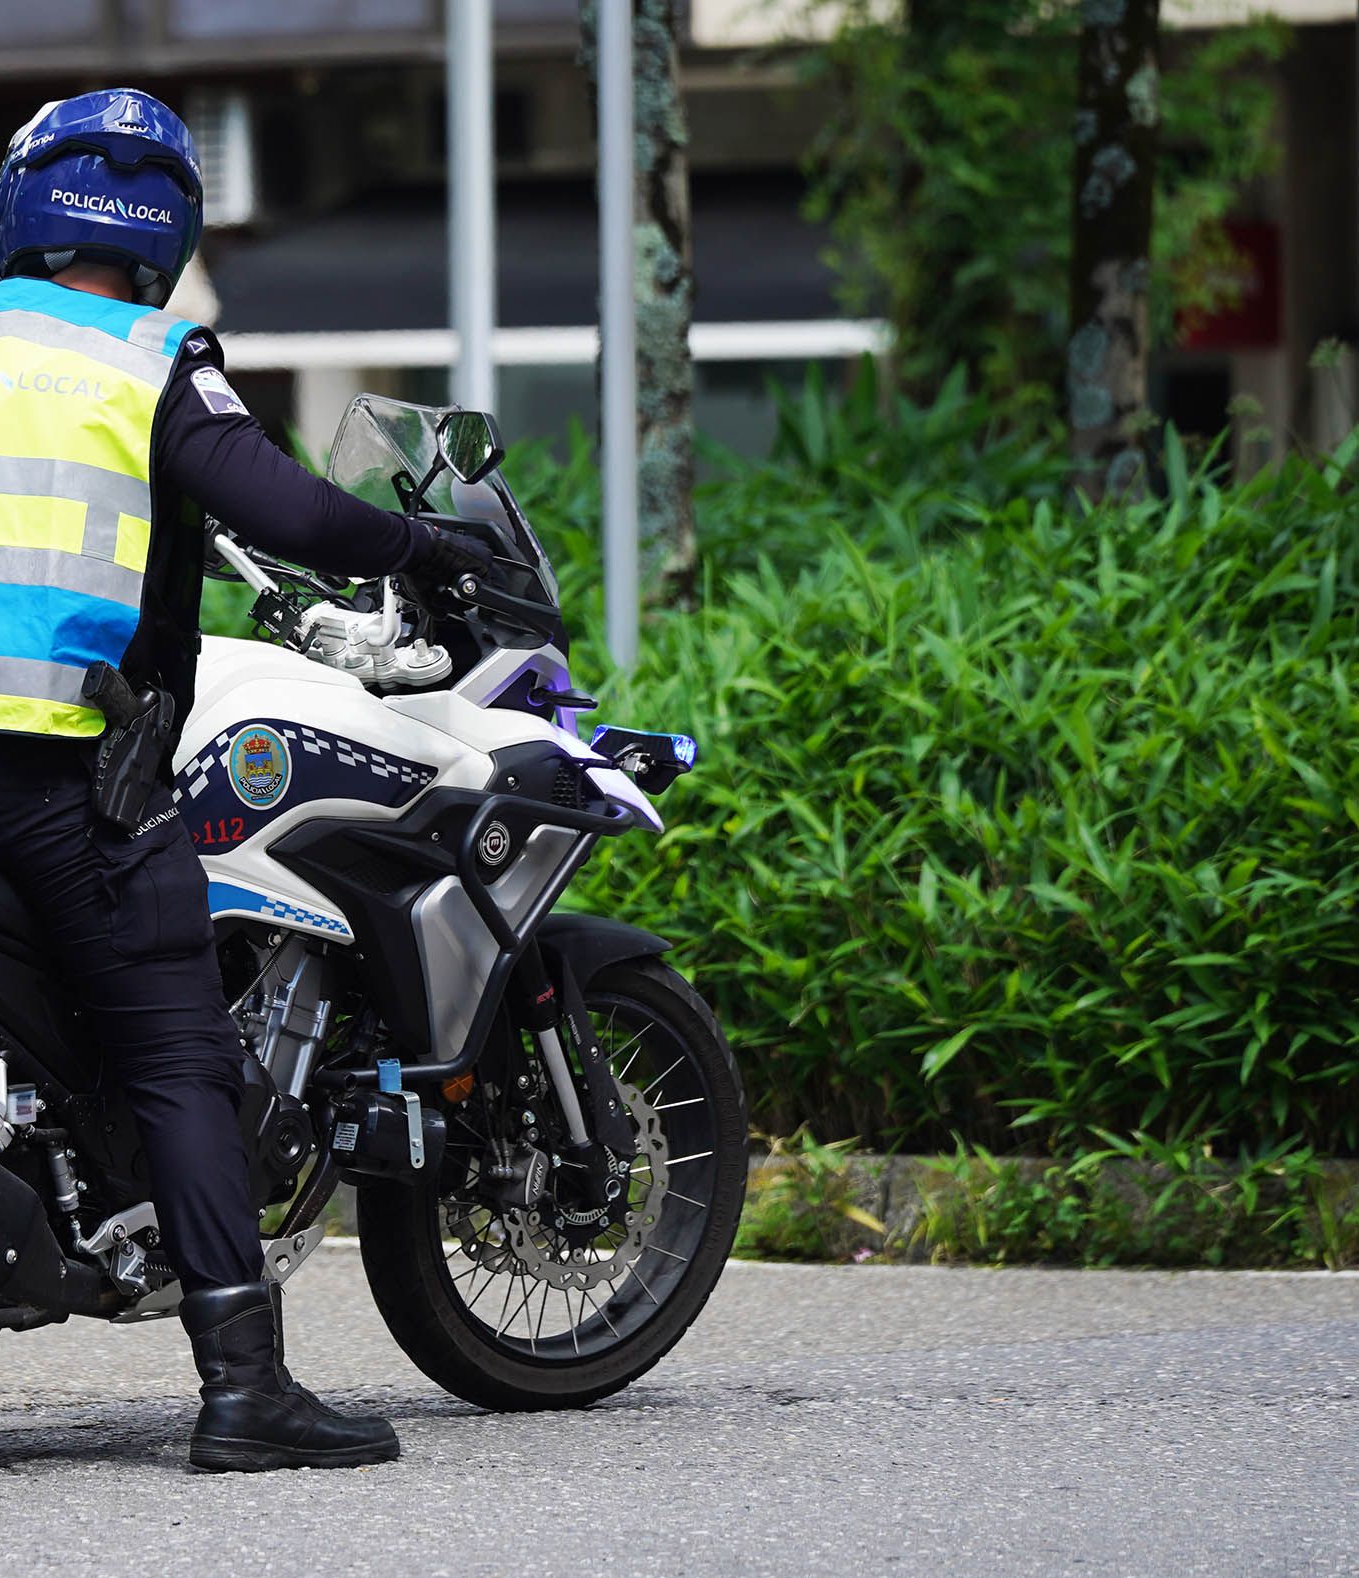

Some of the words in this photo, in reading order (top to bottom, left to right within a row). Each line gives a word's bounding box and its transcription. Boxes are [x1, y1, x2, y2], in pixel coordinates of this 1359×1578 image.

[50, 188, 116, 214] POLICÍA
[127, 204, 173, 224] LOCAL
[17, 372, 106, 400] LOCAL
